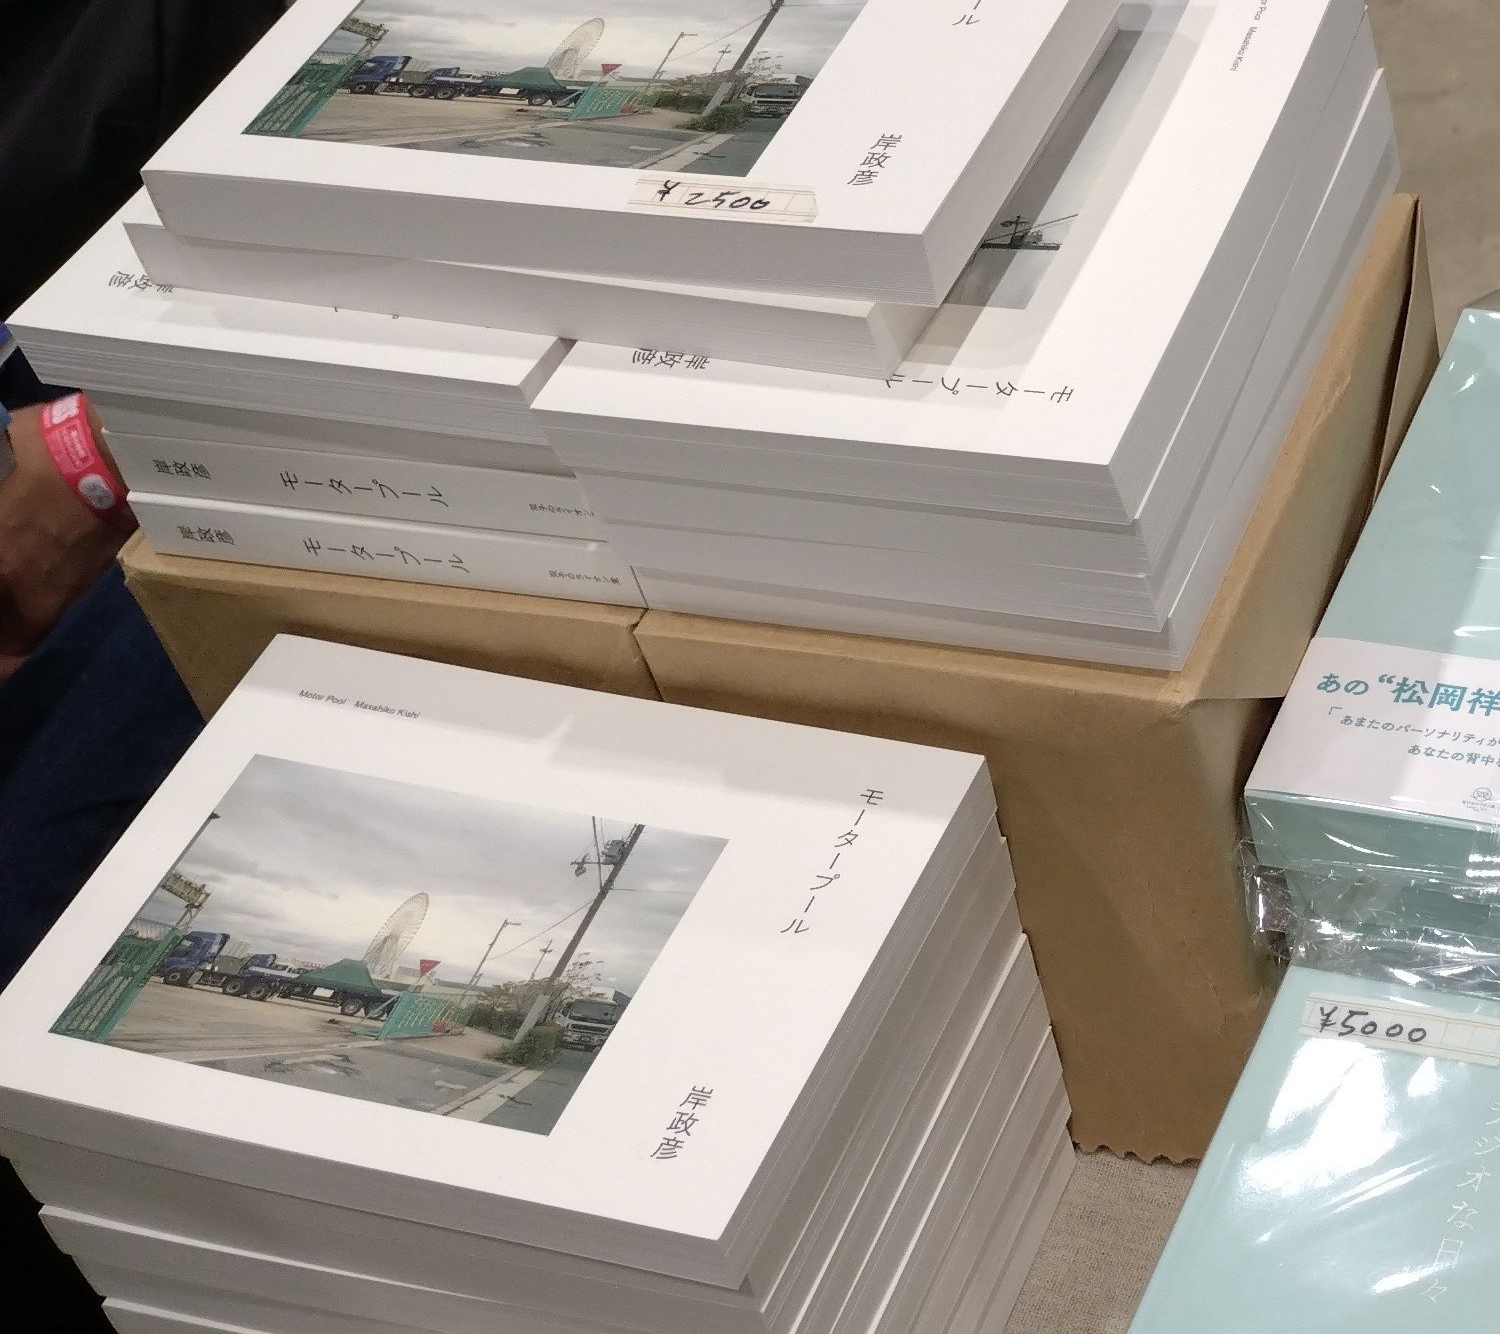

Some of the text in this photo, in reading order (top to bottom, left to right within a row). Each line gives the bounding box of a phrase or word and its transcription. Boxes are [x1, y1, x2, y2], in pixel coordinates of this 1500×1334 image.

[846, 133, 903, 187] 岸政彦
[658, 181, 770, 211] ¥2500
[154, 458, 213, 480] 岸政彦
[280, 470, 449, 508] モータープール
[176, 524, 236, 546] 岸政彦
[304, 536, 471, 574] モータープール
[298, 689, 324, 701] Motor
[325, 694, 347, 705] Pool
[354, 700, 396, 715] Masahiko
[779, 788, 885, 936] モータープール
[1315, 1004, 1428, 1047] ¥5000
[650, 1084, 713, 1161] 岸政彦
